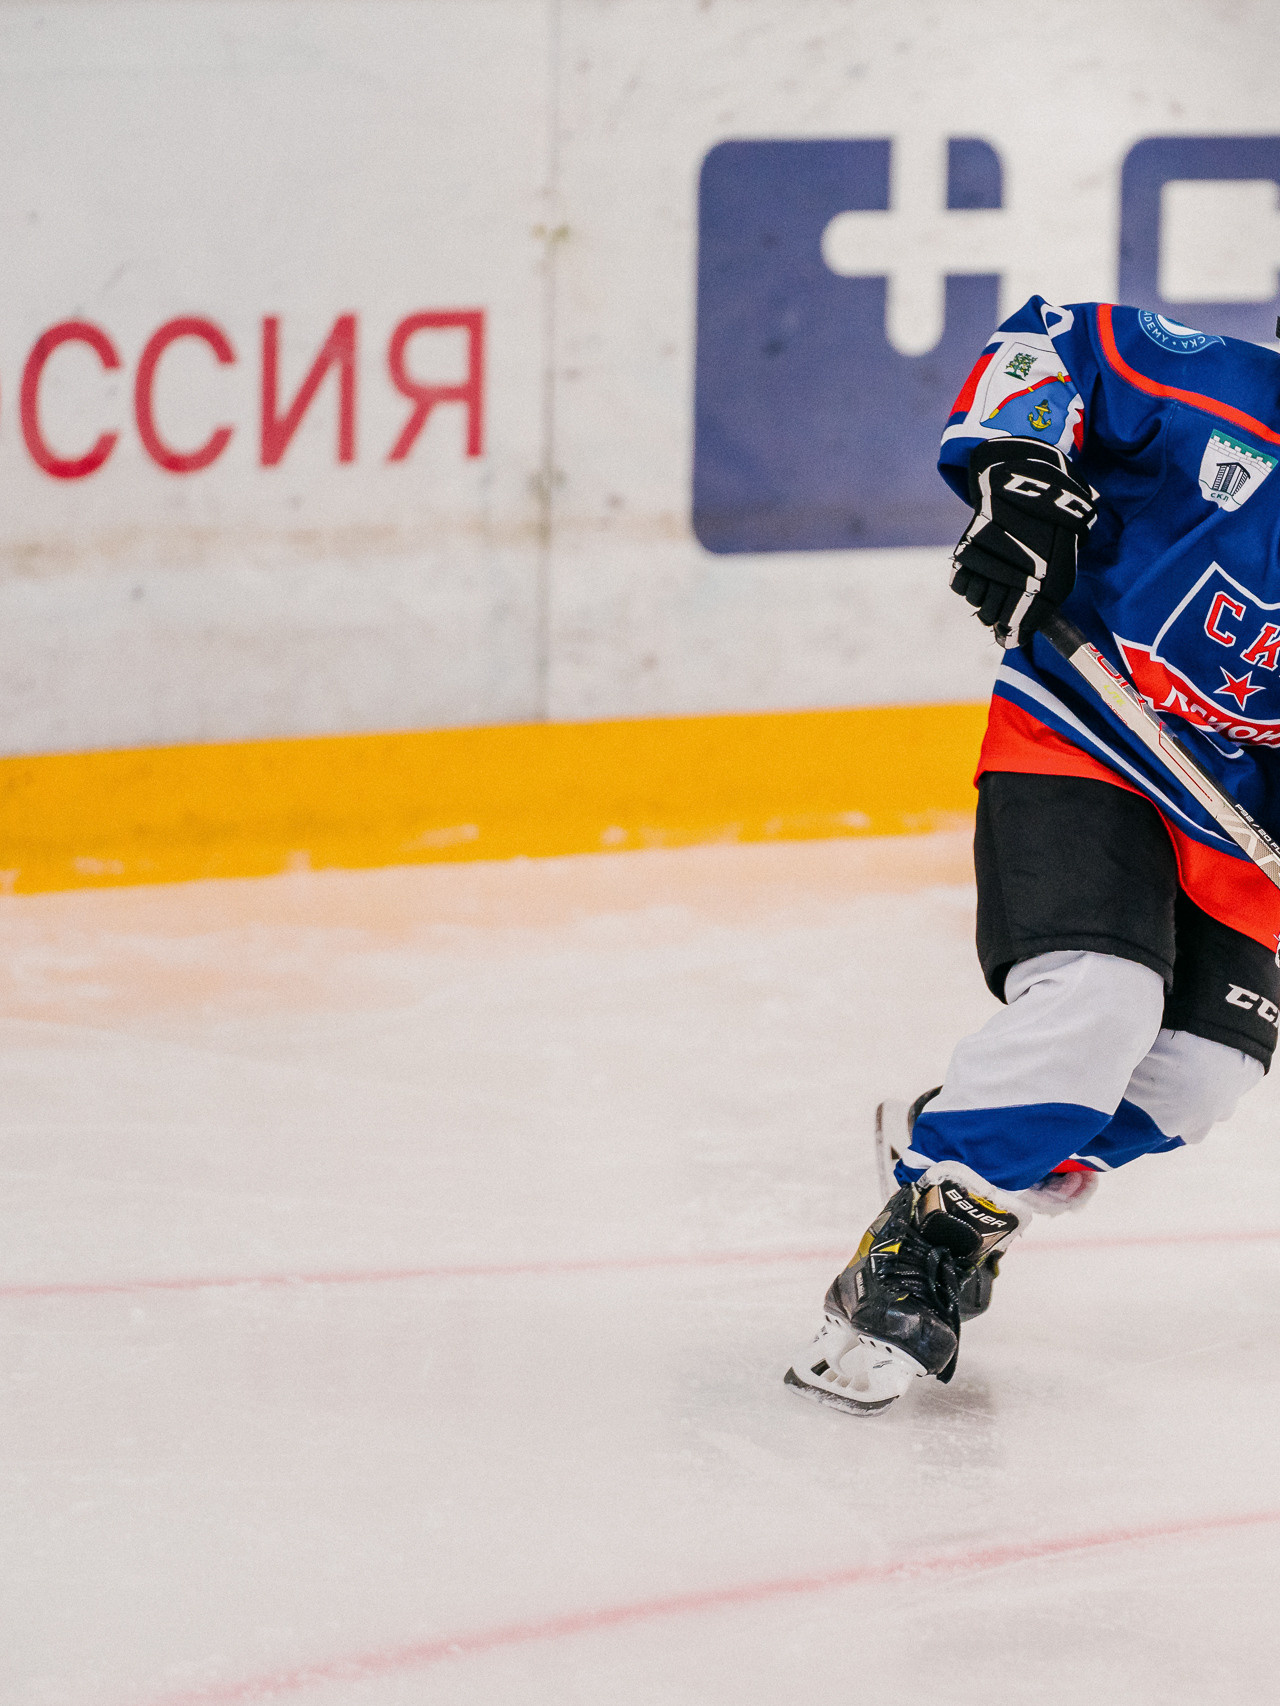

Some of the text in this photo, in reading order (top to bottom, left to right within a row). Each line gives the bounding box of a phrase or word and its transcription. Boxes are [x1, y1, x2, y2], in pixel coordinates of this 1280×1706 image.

[0, 307, 487, 482] ССИЯ
[1003, 473, 1098, 530] CC
[1225, 983, 1280, 1029] CC
